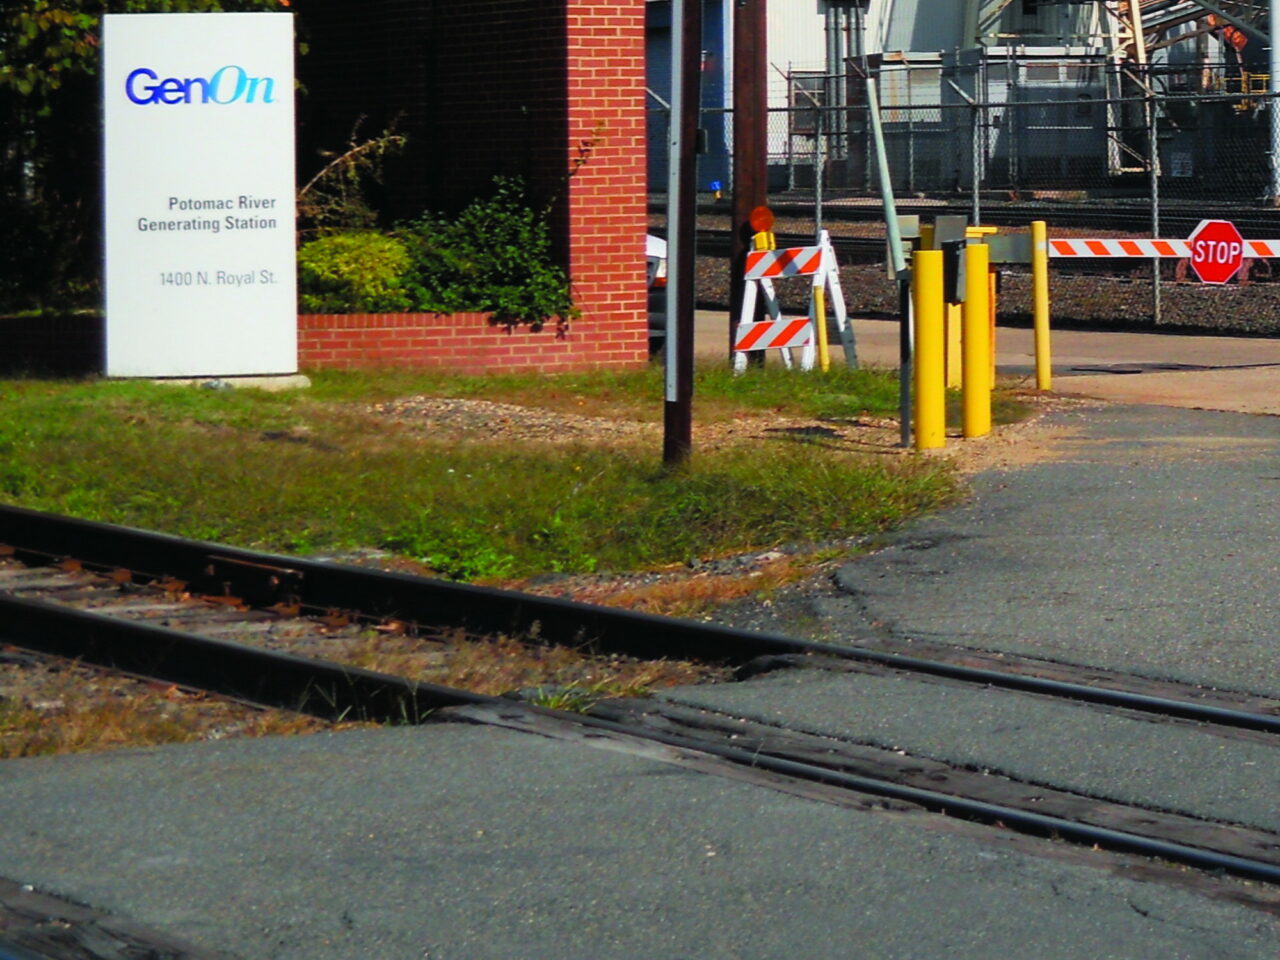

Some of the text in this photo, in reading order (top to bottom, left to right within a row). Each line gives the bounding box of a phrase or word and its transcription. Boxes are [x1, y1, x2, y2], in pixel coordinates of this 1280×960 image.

[126, 65, 274, 105] GenOn
[168, 195, 277, 211] Potomac River
[137, 216, 277, 234] Generating Station
[1194, 240, 1240, 264] STOP
[160, 269, 277, 287] 1400 N. Royal St.
